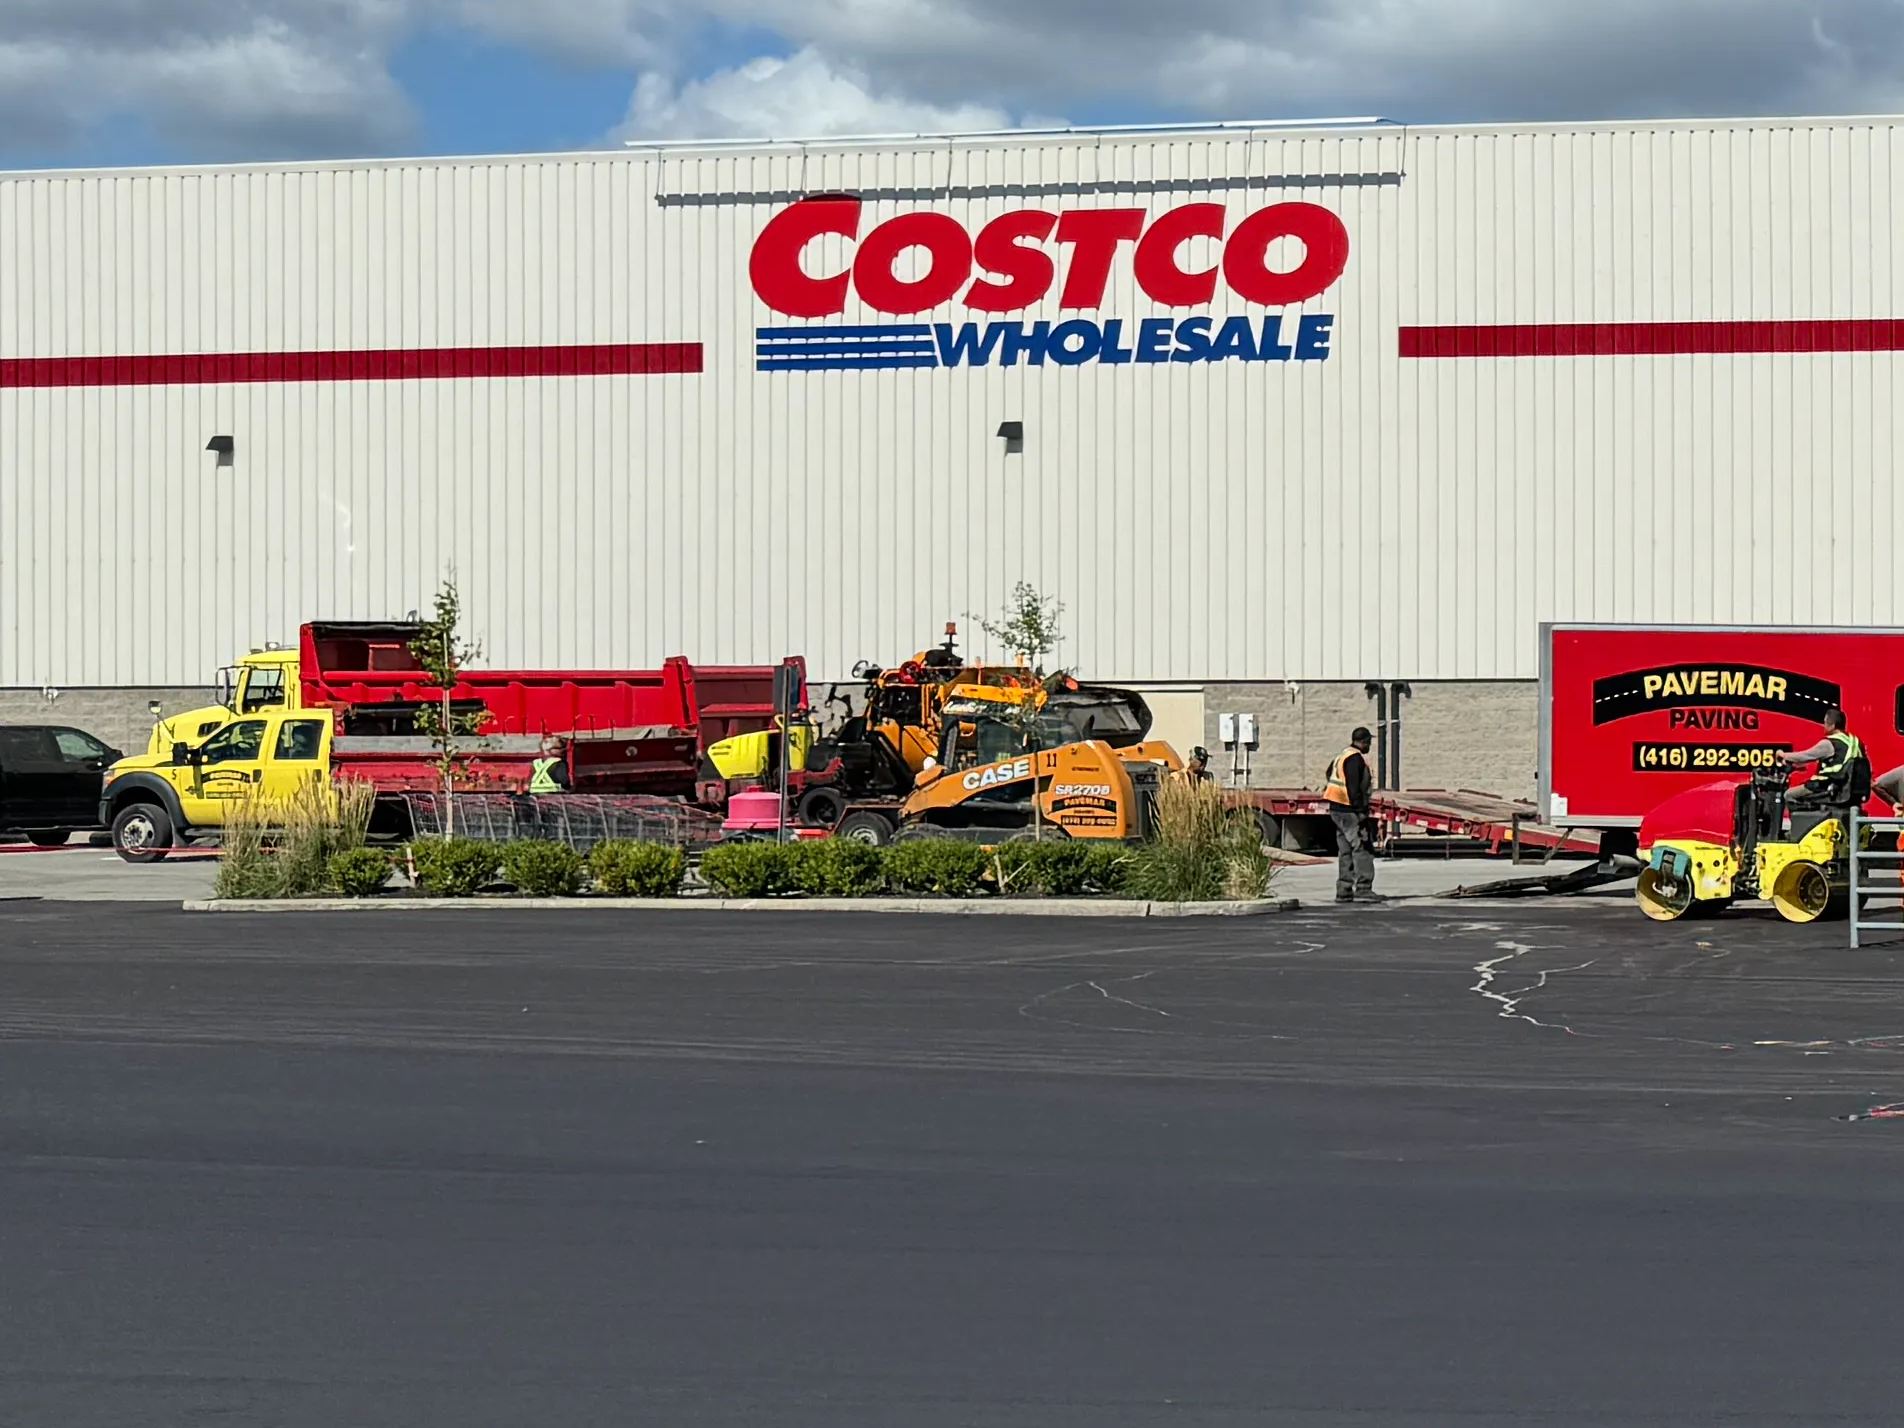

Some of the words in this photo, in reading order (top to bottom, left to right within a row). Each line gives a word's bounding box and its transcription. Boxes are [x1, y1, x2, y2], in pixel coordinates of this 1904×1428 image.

[749, 194, 1349, 318] COSTCO
[933, 314, 1334, 367] WHOLESALE
[1643, 671, 1787, 701] PAVEMAR
[1669, 708, 1759, 730] PAVING
[1640, 746, 1687, 768] (416)
[962, 758, 1031, 790] CASE
